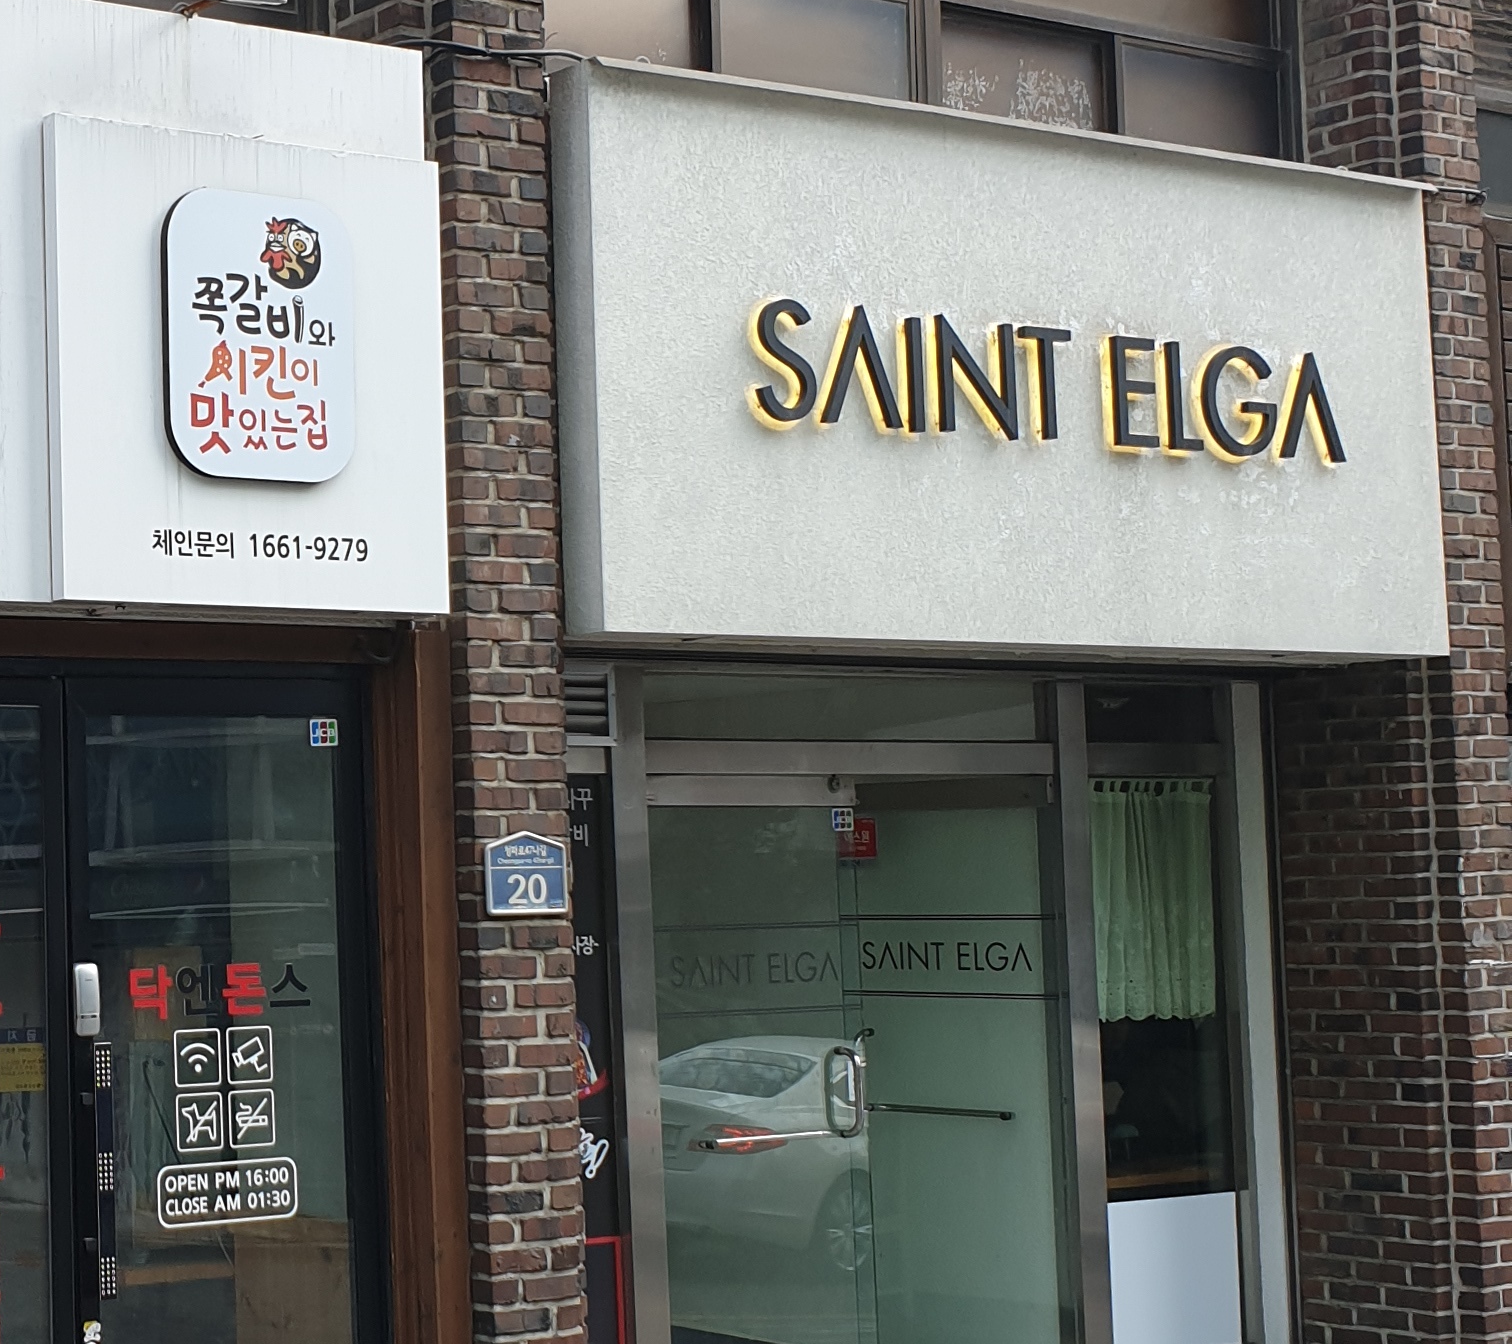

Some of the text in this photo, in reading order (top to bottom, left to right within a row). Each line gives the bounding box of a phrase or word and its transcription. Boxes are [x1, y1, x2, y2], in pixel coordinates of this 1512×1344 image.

[191, 273, 336, 347] 쪽갈비와
[197, 340, 319, 400] 치킨이
[754, 298, 1346, 464] SAINT ELGA
[190, 391, 328, 454] 맛있는집
[152, 529, 369, 562] 체인문의 1661-9279
[507, 873, 547, 904] 20
[768, 951, 838, 984] ELGA
[861, 941, 1033, 971] SAINT ELGA
[129, 963, 311, 1020] 닥엔돈스
[165, 1166, 289, 1193] OPEN PM 16:00
[165, 1189, 291, 1216] CLOSE AM 01:30
